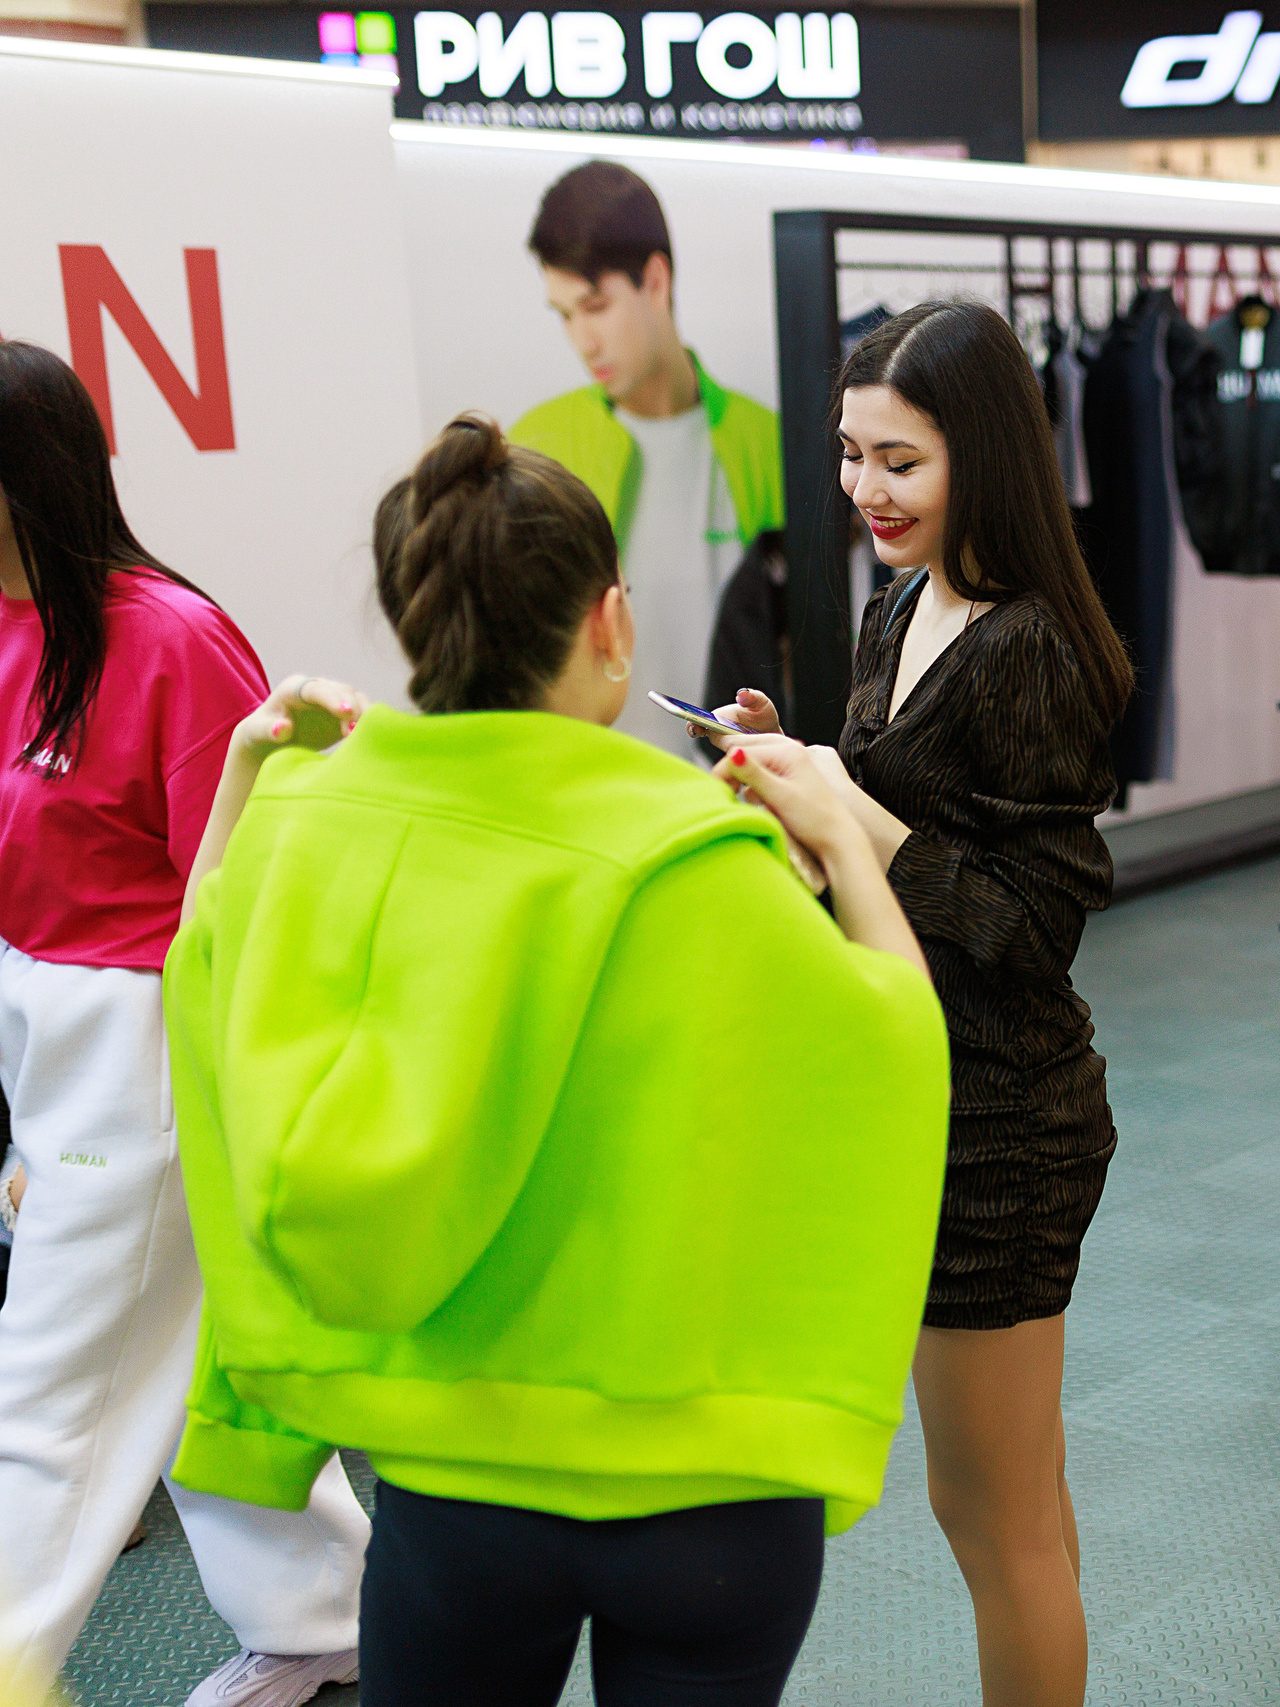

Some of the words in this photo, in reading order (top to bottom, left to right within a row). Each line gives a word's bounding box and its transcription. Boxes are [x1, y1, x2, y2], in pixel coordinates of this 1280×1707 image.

[414, 11, 628, 98] РИВ
[641, 11, 861, 99] ГОШ
[0, 243, 236, 456] N
[60, 1153, 108, 1168] HUMAN
